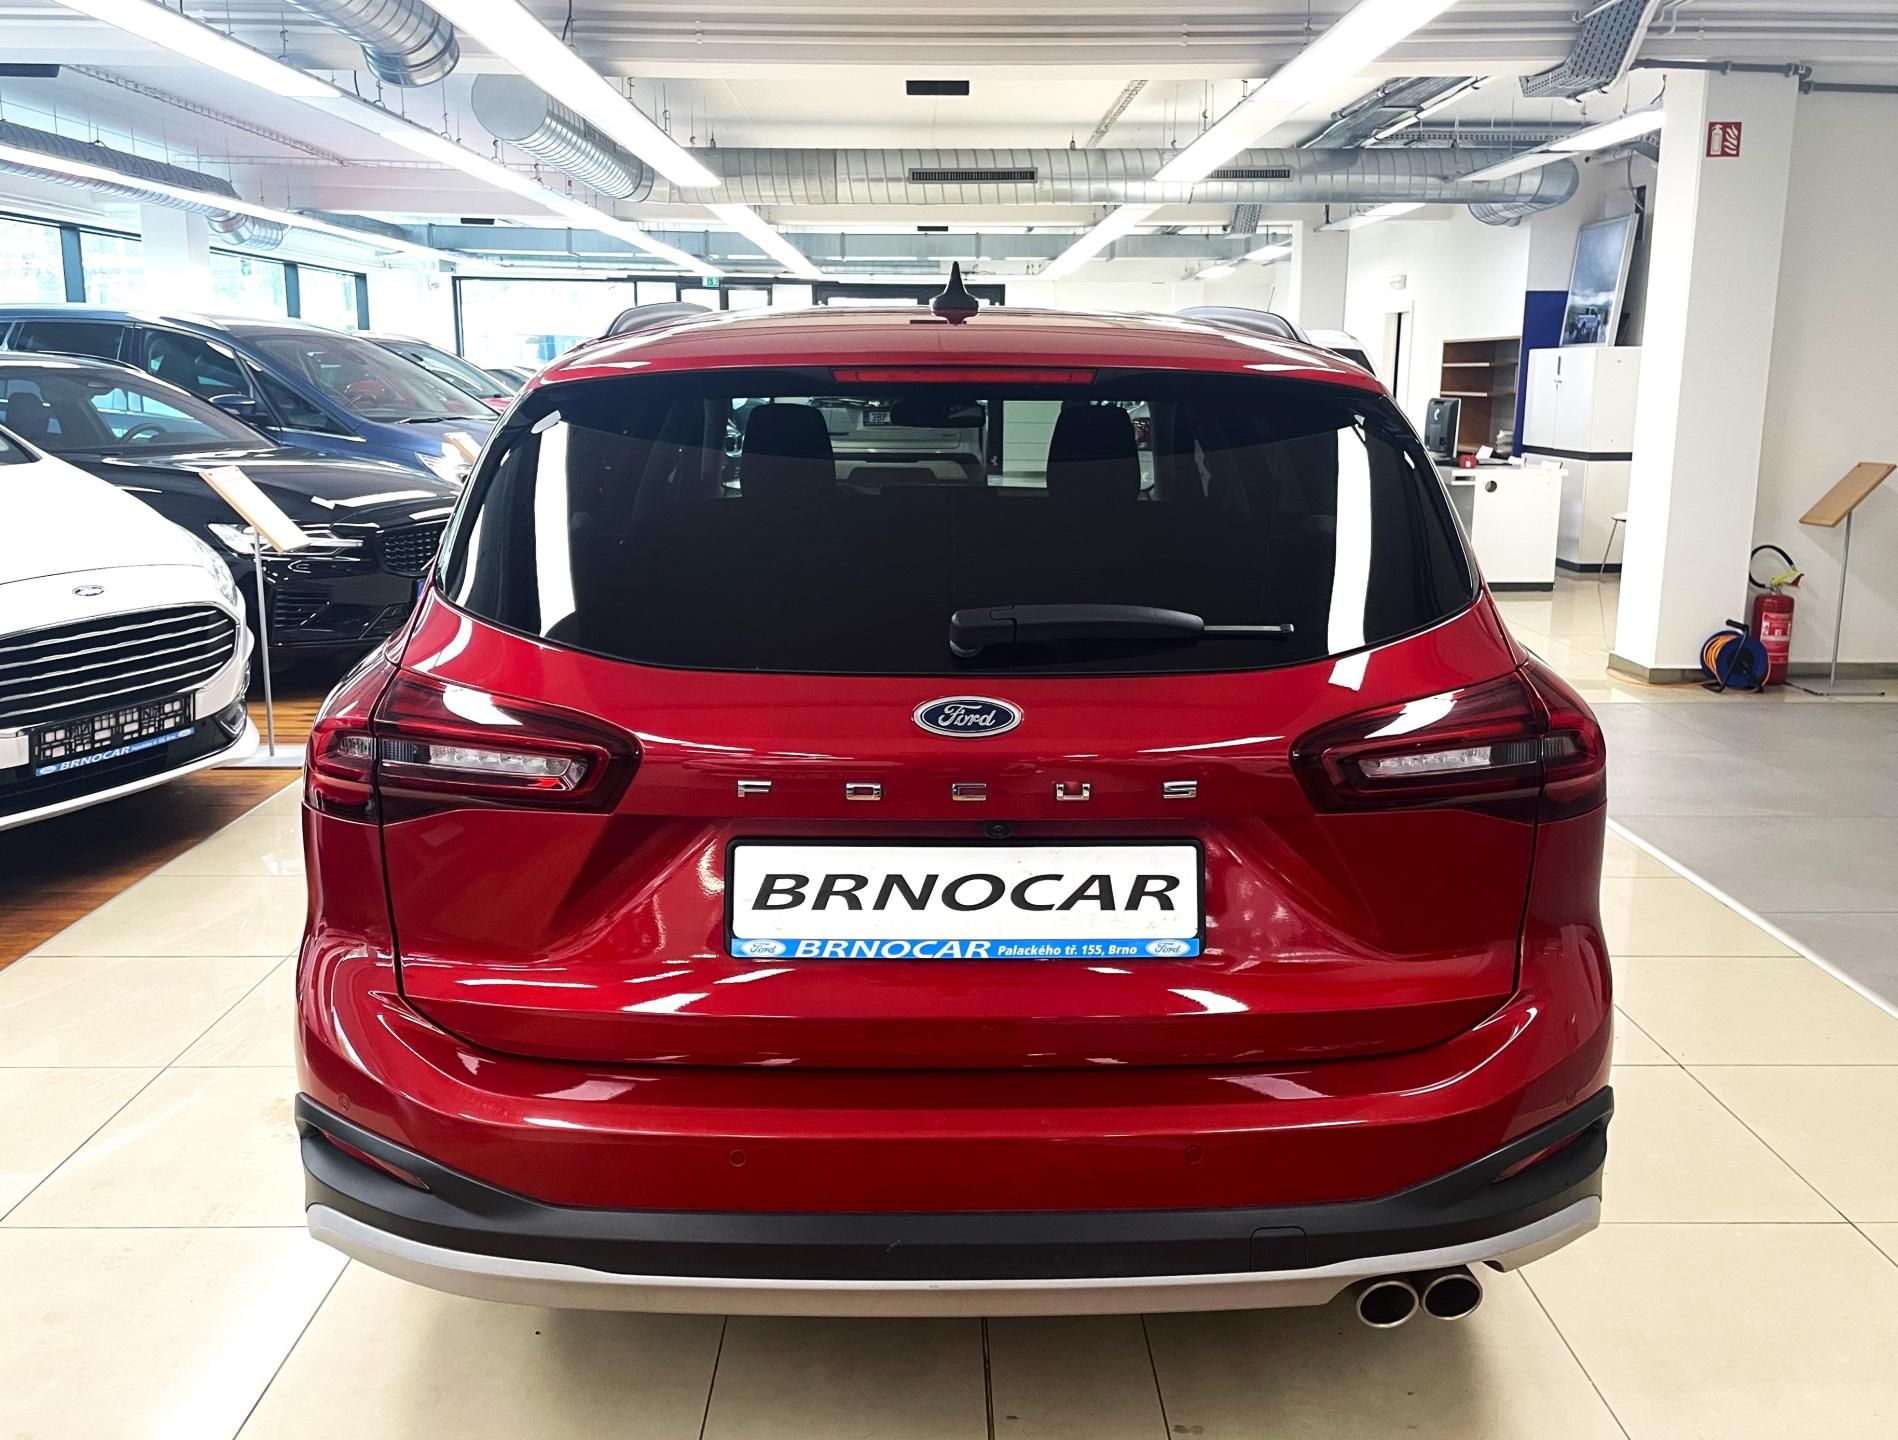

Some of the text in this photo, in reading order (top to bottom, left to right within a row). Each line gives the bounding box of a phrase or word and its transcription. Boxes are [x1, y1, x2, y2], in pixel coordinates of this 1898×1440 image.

[938, 704, 997, 727] Ford
[60, 746, 130, 770] BRNOCAR
[737, 780, 1197, 801] FOCUS
[752, 873, 1180, 911] BRNOCAR
[750, 943, 776, 954] Ford
[795, 940, 991, 958] BRNOCAR
[997, 944, 1137, 957] Palackého tř. 155, Brno
[1154, 942, 1181, 954] Ford
